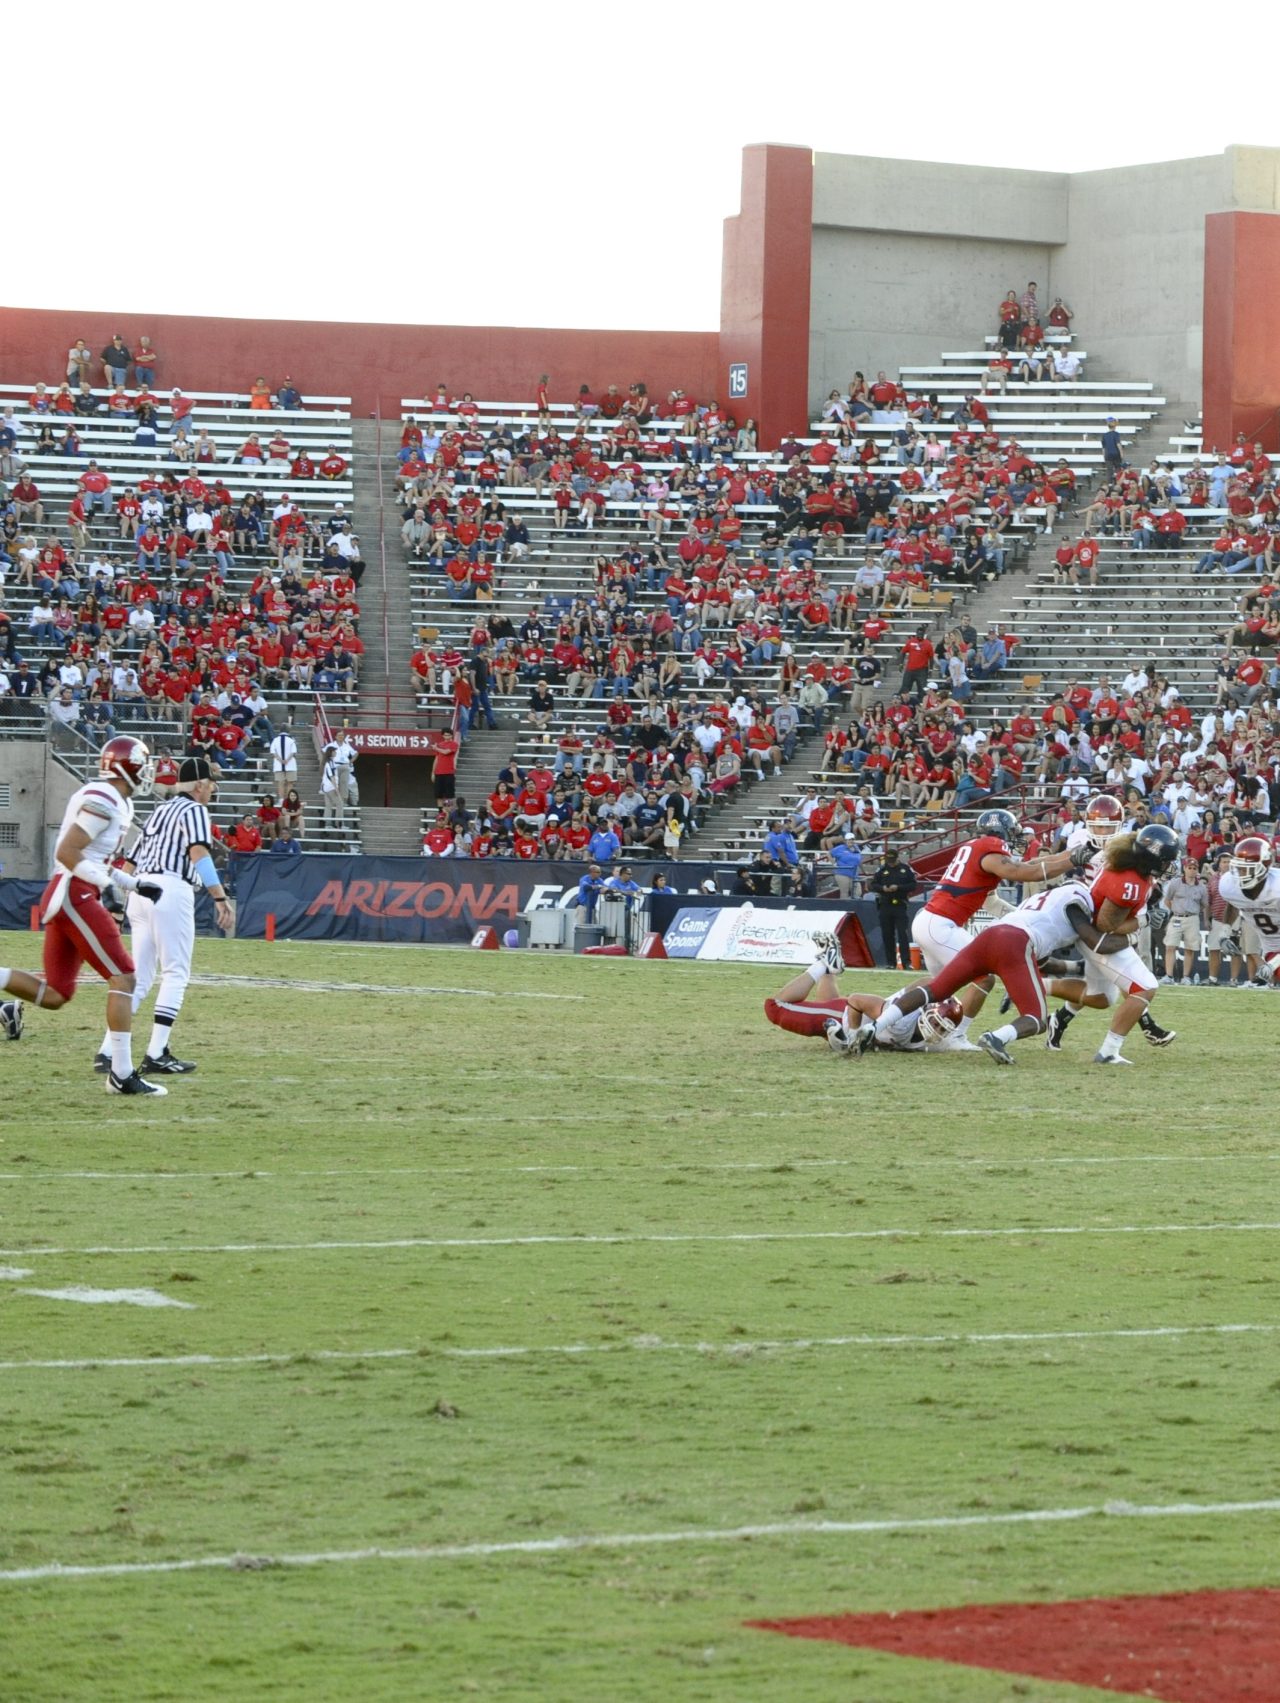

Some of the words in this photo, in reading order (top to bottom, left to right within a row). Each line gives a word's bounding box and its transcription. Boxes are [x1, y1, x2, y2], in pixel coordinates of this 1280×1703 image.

[731, 369, 746, 392] 15
[21, 681, 28, 694] 7
[354, 734, 364, 746] 14
[367, 735, 407, 748] SECTION
[409, 736, 420, 748] 15
[306, 880, 520, 921] ARIZONA
[1121, 881, 1140, 901] 31
[679, 917, 710, 932] Game
[471, 929, 486, 948] G
